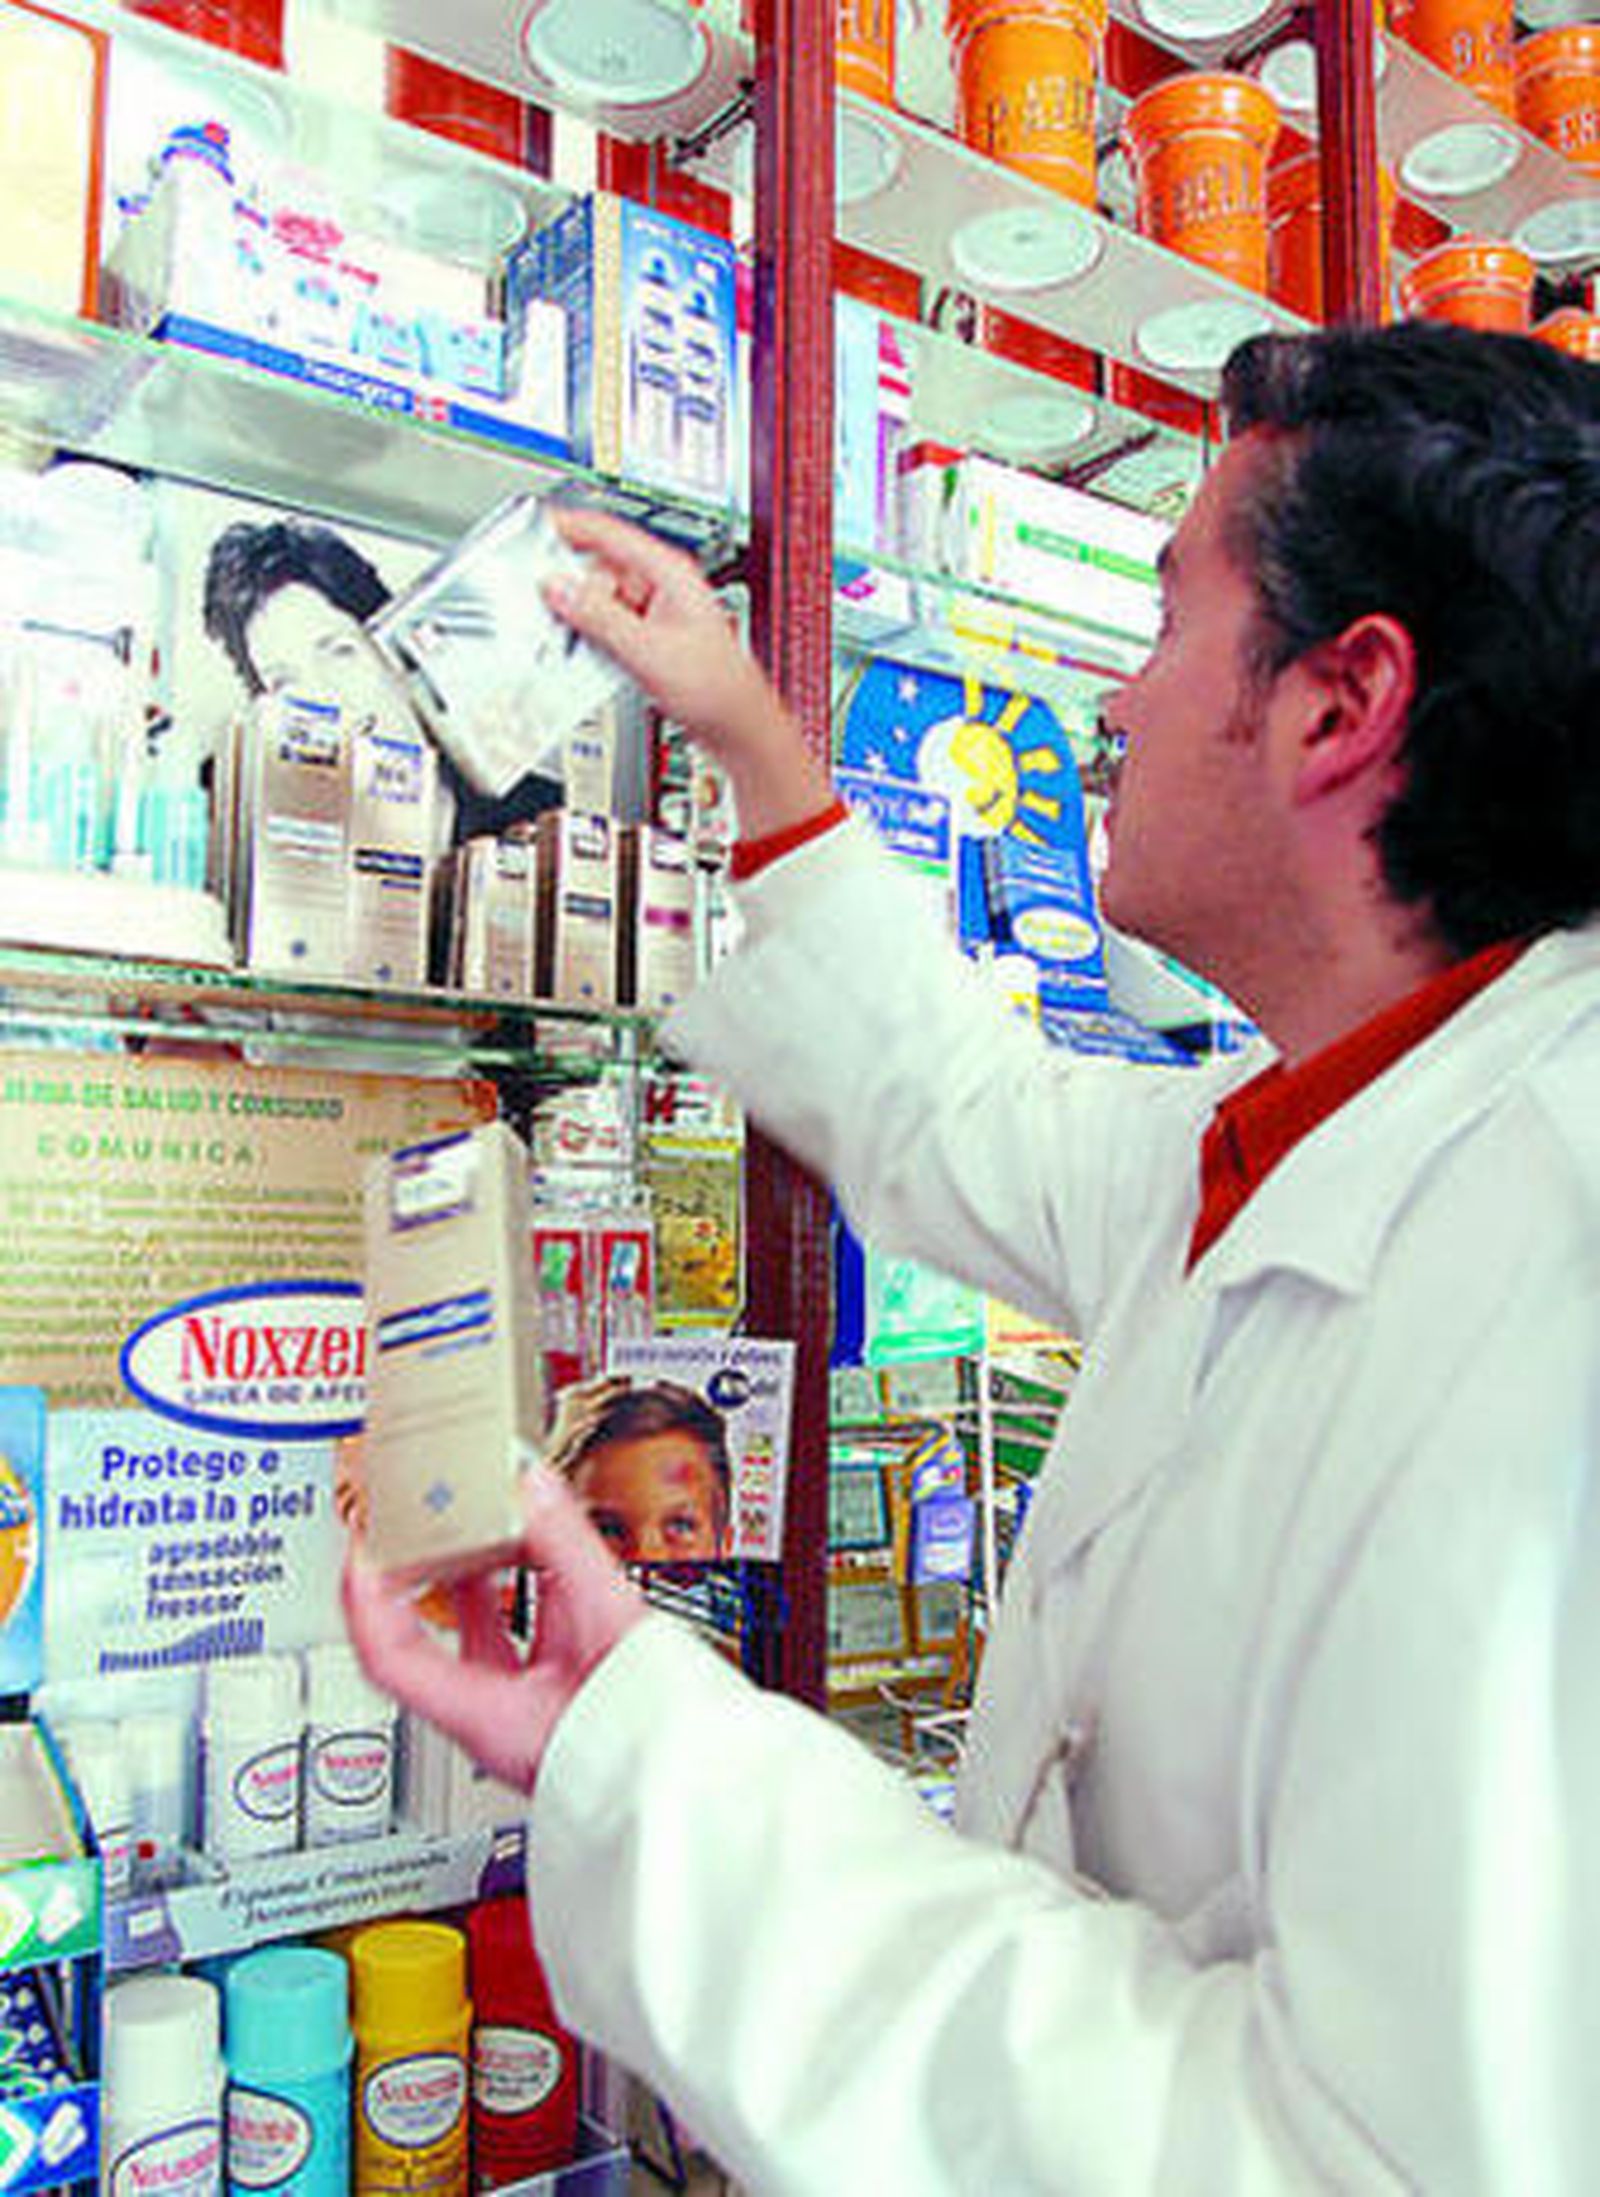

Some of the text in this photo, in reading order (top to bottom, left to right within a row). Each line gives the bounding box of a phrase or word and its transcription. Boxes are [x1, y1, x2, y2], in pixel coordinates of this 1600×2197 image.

[101, 1446, 280, 1482] Protege e
[59, 1483, 314, 1529] hidrata la piel
